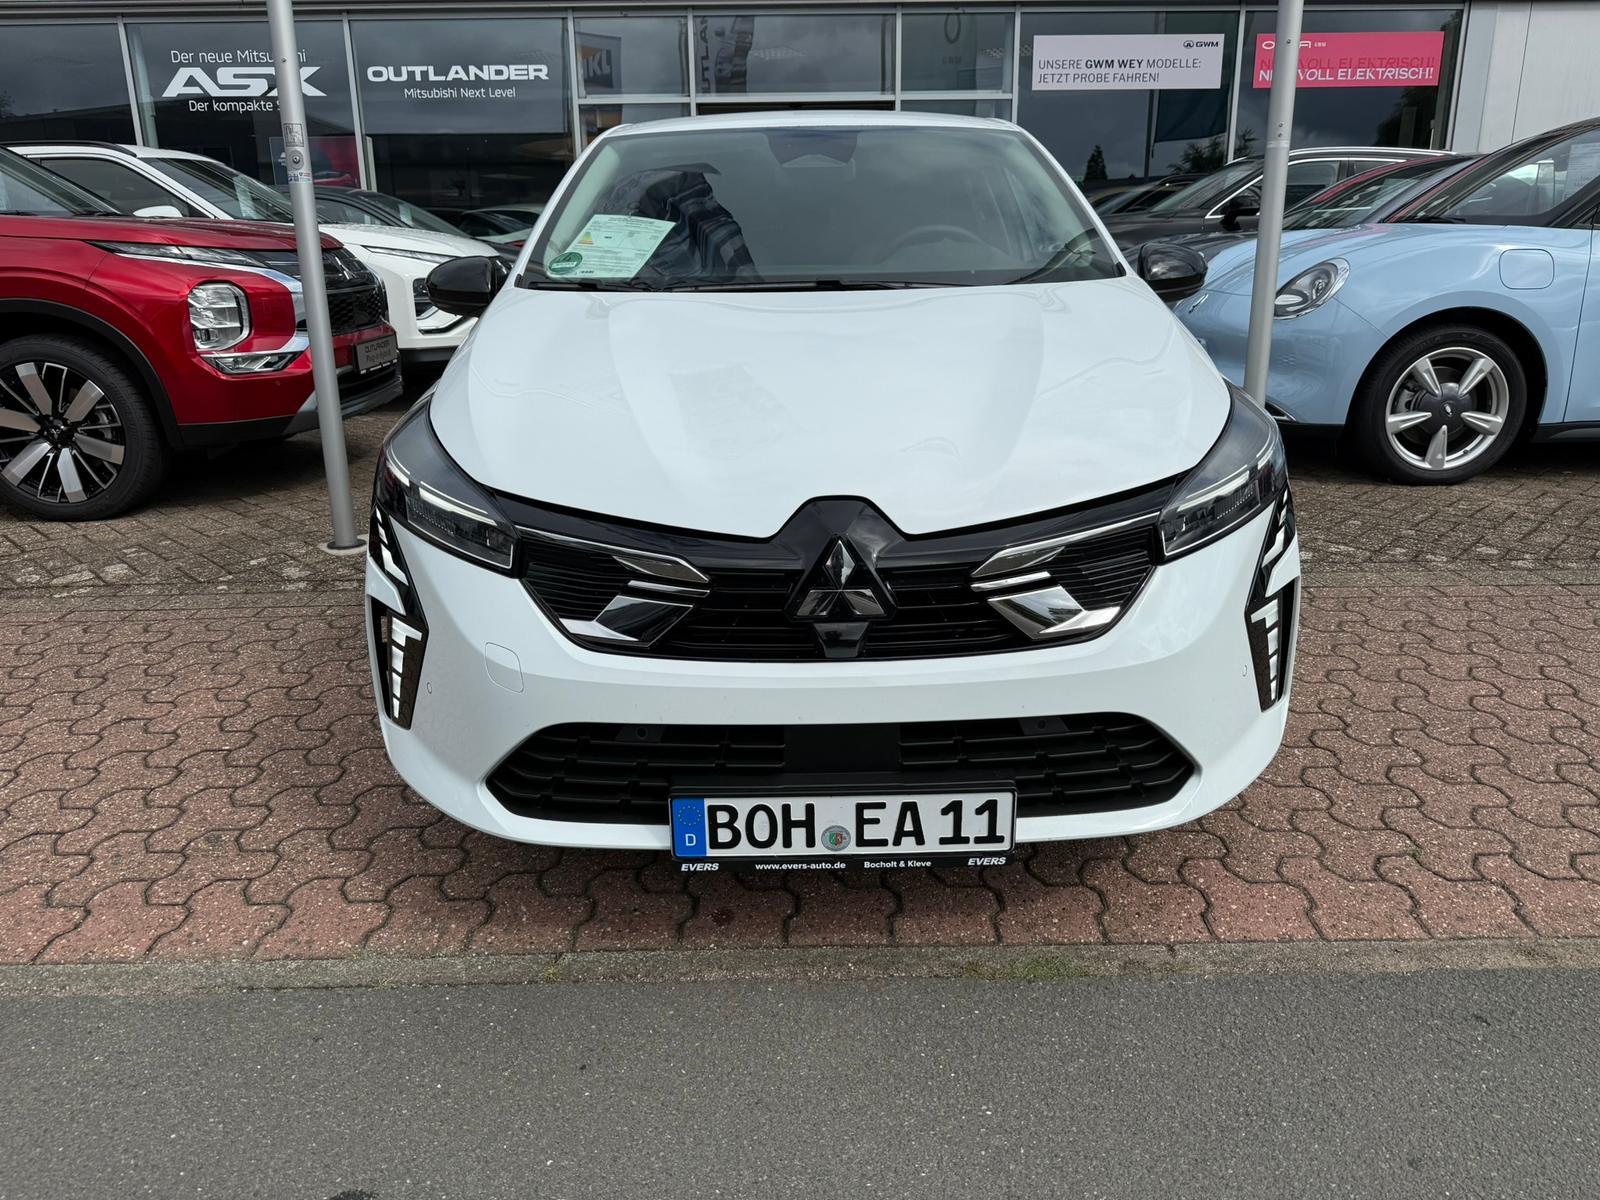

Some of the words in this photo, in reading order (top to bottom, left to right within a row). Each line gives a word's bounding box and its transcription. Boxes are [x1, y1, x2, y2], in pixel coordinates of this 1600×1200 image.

[170, 50, 194, 63] Der
[199, 52, 233, 63] neue
[1038, 58, 1083, 70] UNSERE
[1085, 59, 1115, 69] GWM
[1117, 58, 1144, 69] WEY
[1146, 57, 1203, 69] MODELLE:
[366, 64, 549, 82] OUTLANDER
[1037, 73, 1071, 84] JETZT
[1072, 72, 1110, 83] PROBE
[1112, 72, 1160, 83] FAHREN!
[1337, 67, 1434, 81] ELEKTRISCH!
[161, 66, 328, 97] ASX
[404, 86, 458, 99] Mitsubishi
[460, 87, 486, 98] Next
[488, 86, 516, 98] Level
[188, 100, 210, 112] Der
[212, 99, 273, 114] kompakte
[707, 802, 816, 850] BOH
[855, 801, 926, 848] EA
[938, 799, 1006, 846] 11
[685, 833, 697, 846] D
[681, 863, 719, 872] EVERS
[755, 860, 847, 871] www.evers-auto.de
[863, 860, 897, 869] Bocholt
[898, 860, 906, 868] &
[907, 859, 932, 868] Kleve
[967, 857, 1006, 866] EVERS
